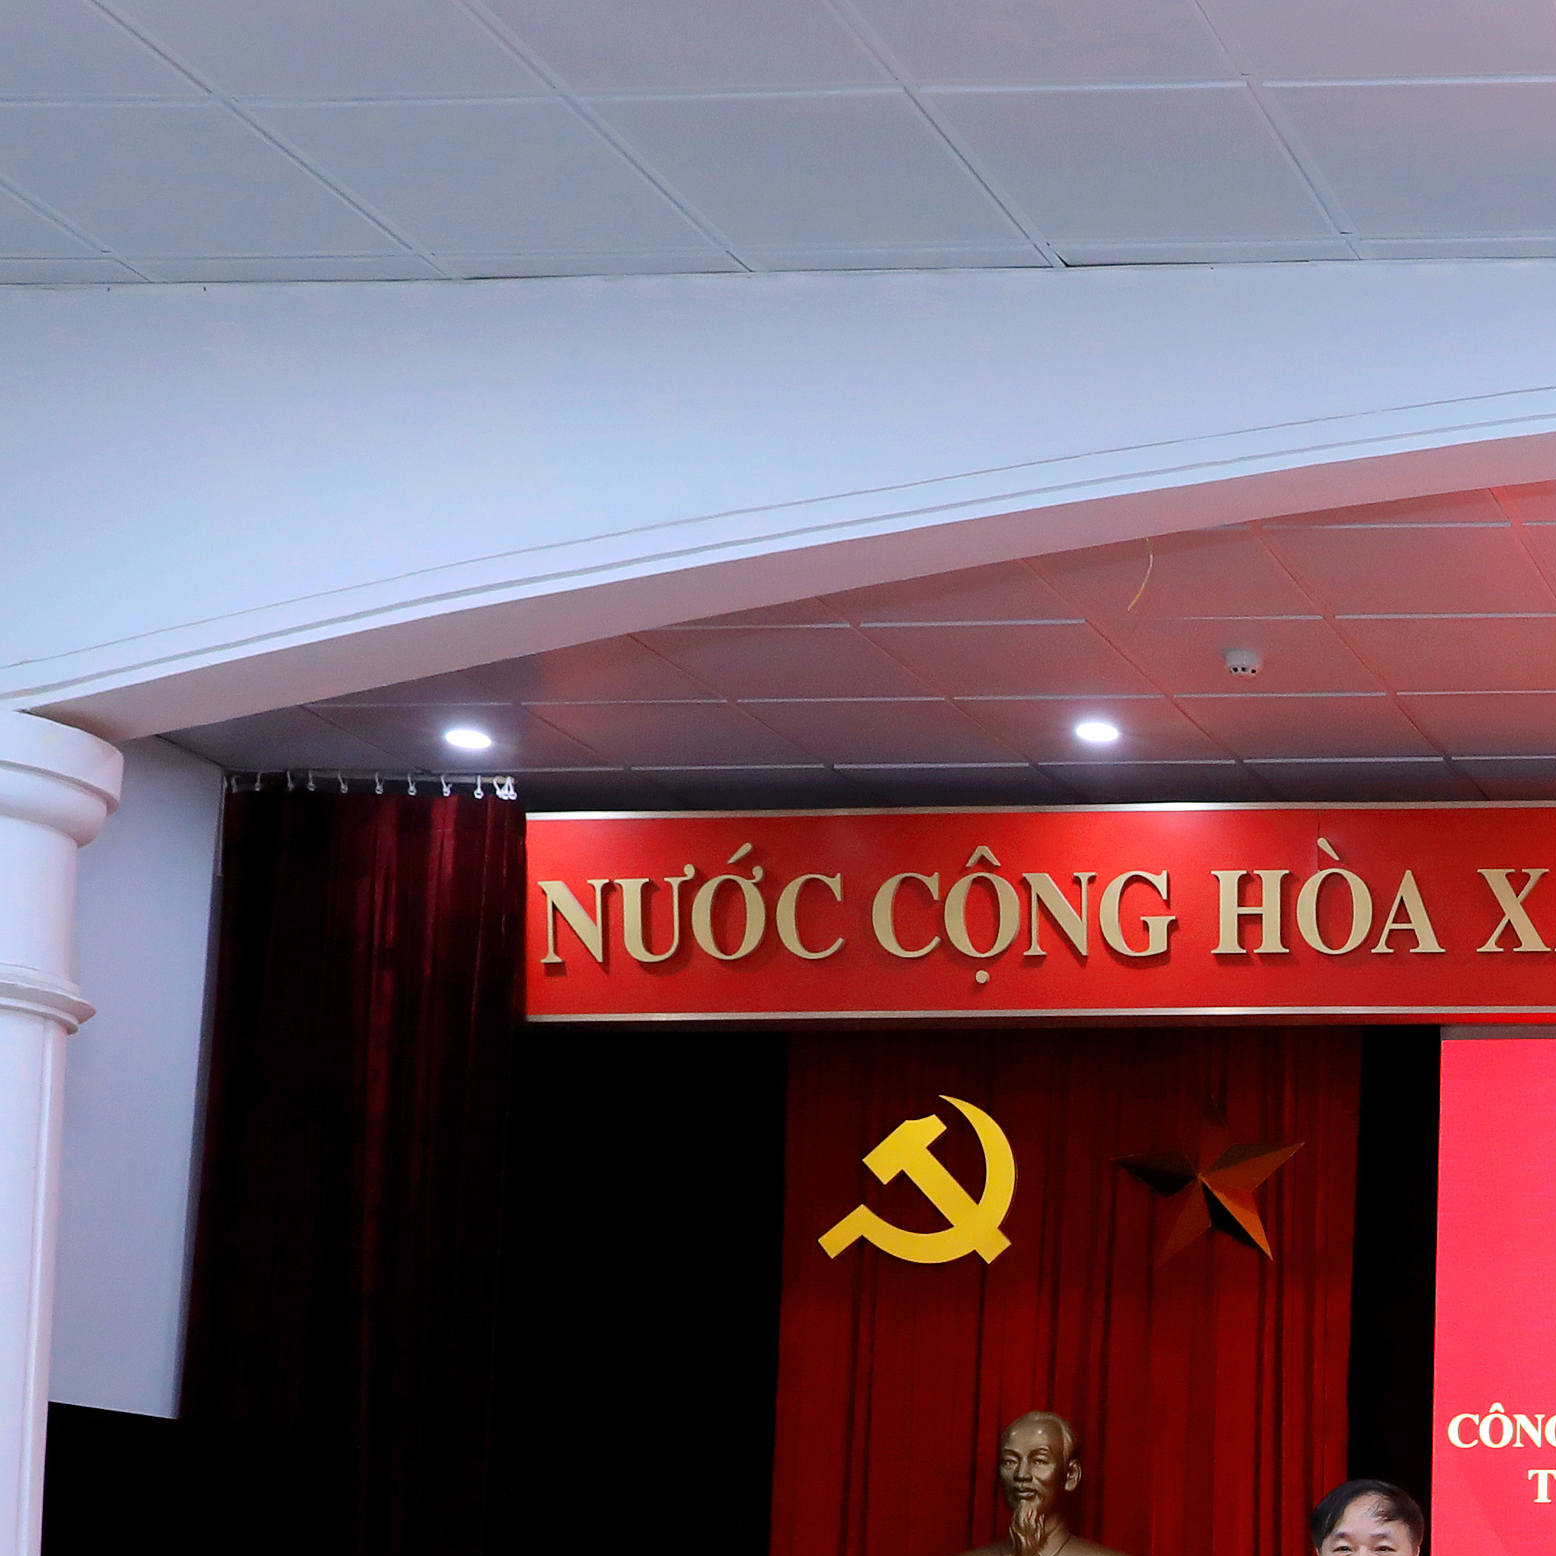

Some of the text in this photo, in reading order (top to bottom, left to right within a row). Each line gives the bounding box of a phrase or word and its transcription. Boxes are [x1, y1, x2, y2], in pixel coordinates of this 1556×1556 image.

[538, 843, 843, 963] NƯỚC
[873, 845, 1176, 984] CỘNG
[1211, 838, 1446, 955] HÒA
